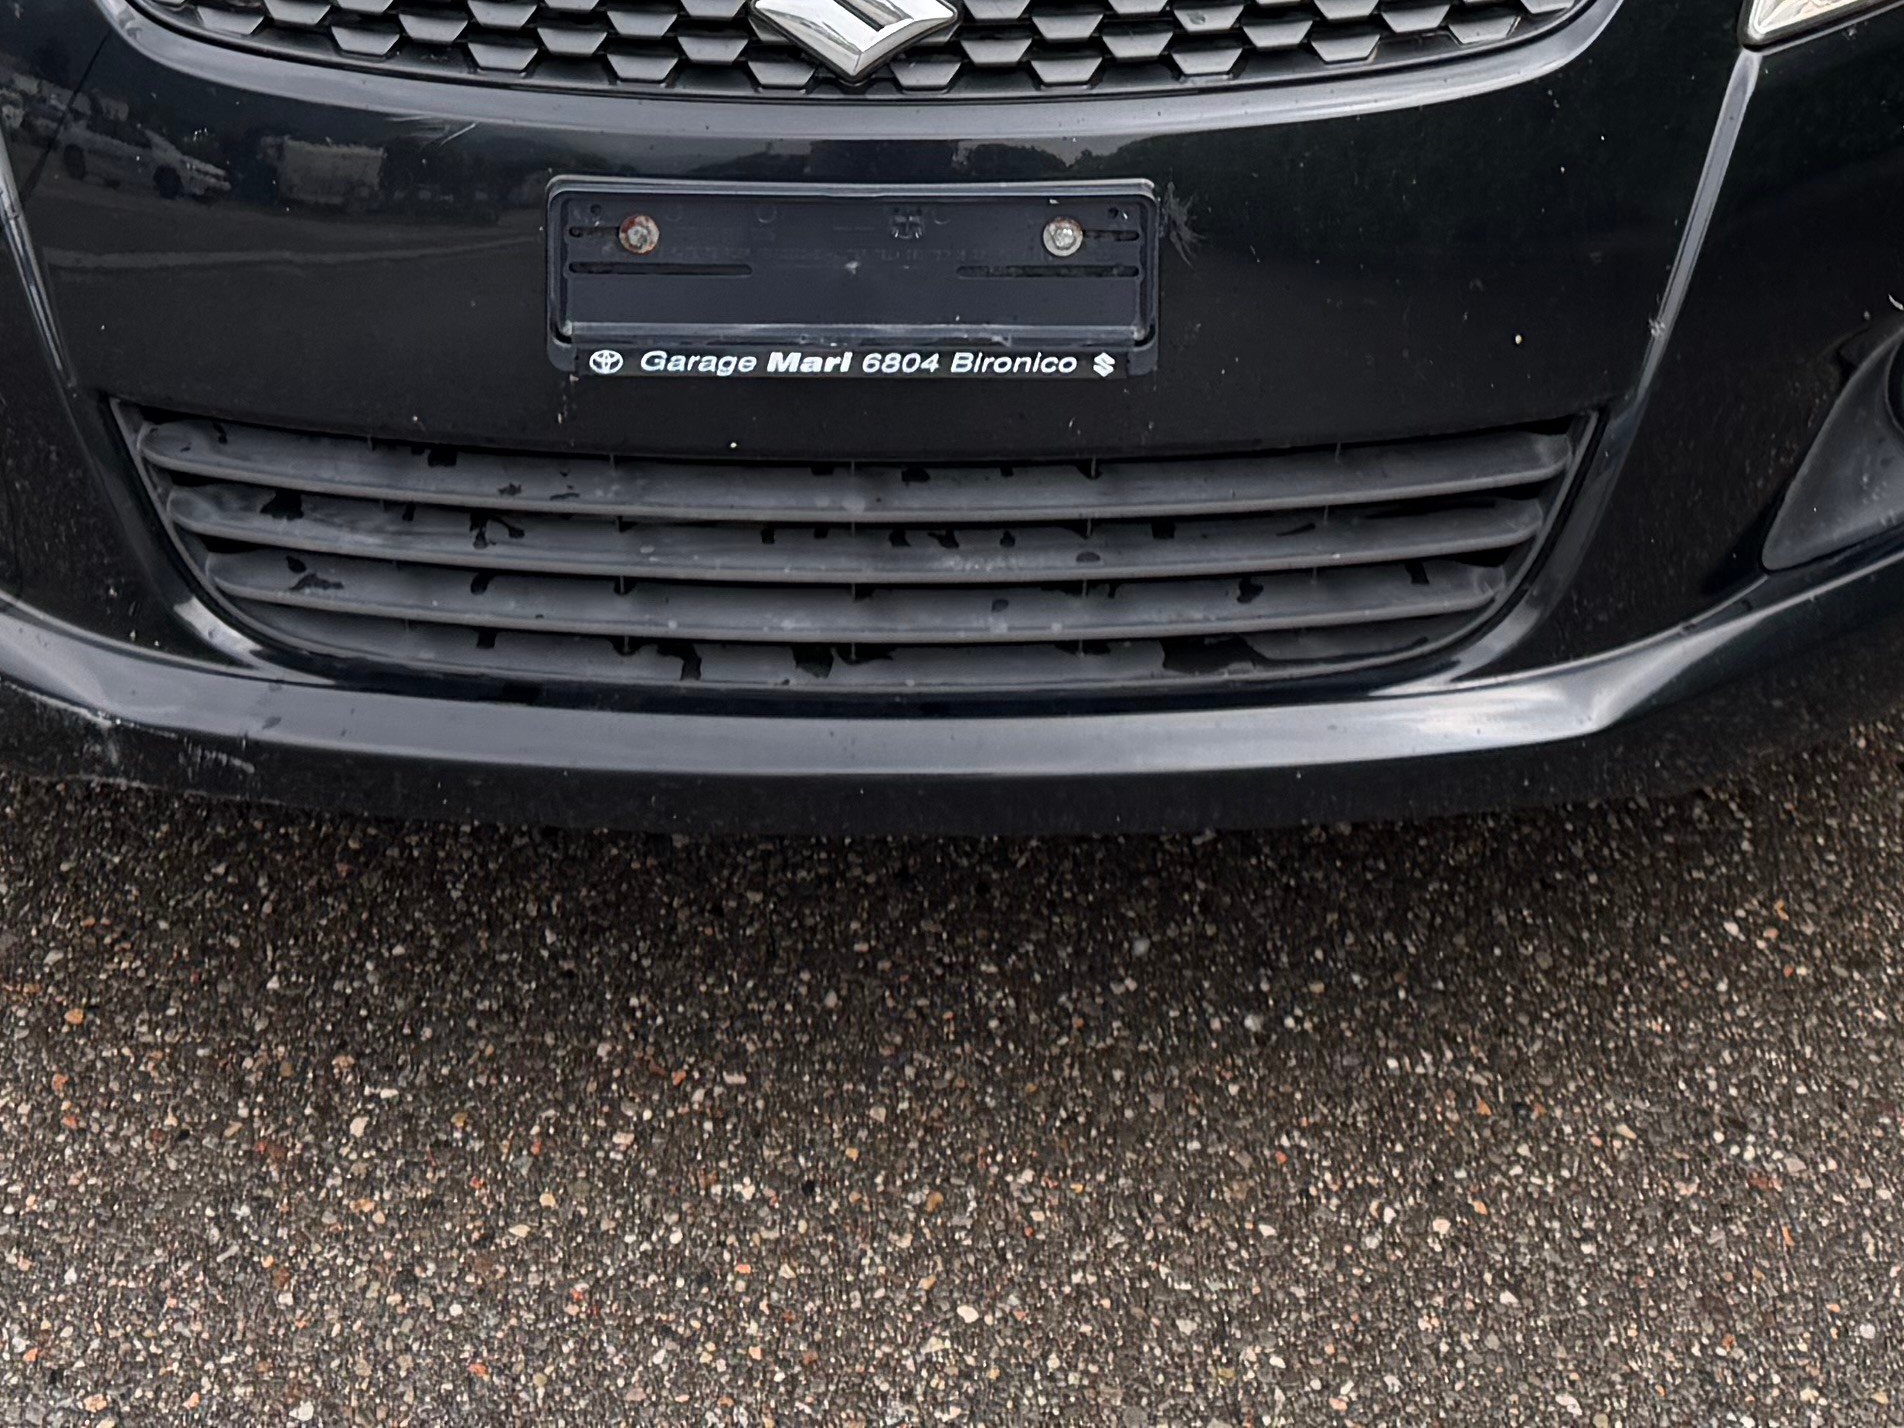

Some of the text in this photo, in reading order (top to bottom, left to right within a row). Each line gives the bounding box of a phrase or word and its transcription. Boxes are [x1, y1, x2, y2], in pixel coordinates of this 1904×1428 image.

[640, 350, 757, 376] Garage
[861, 352, 940, 373] 6804
[950, 351, 1078, 373] Bironico
